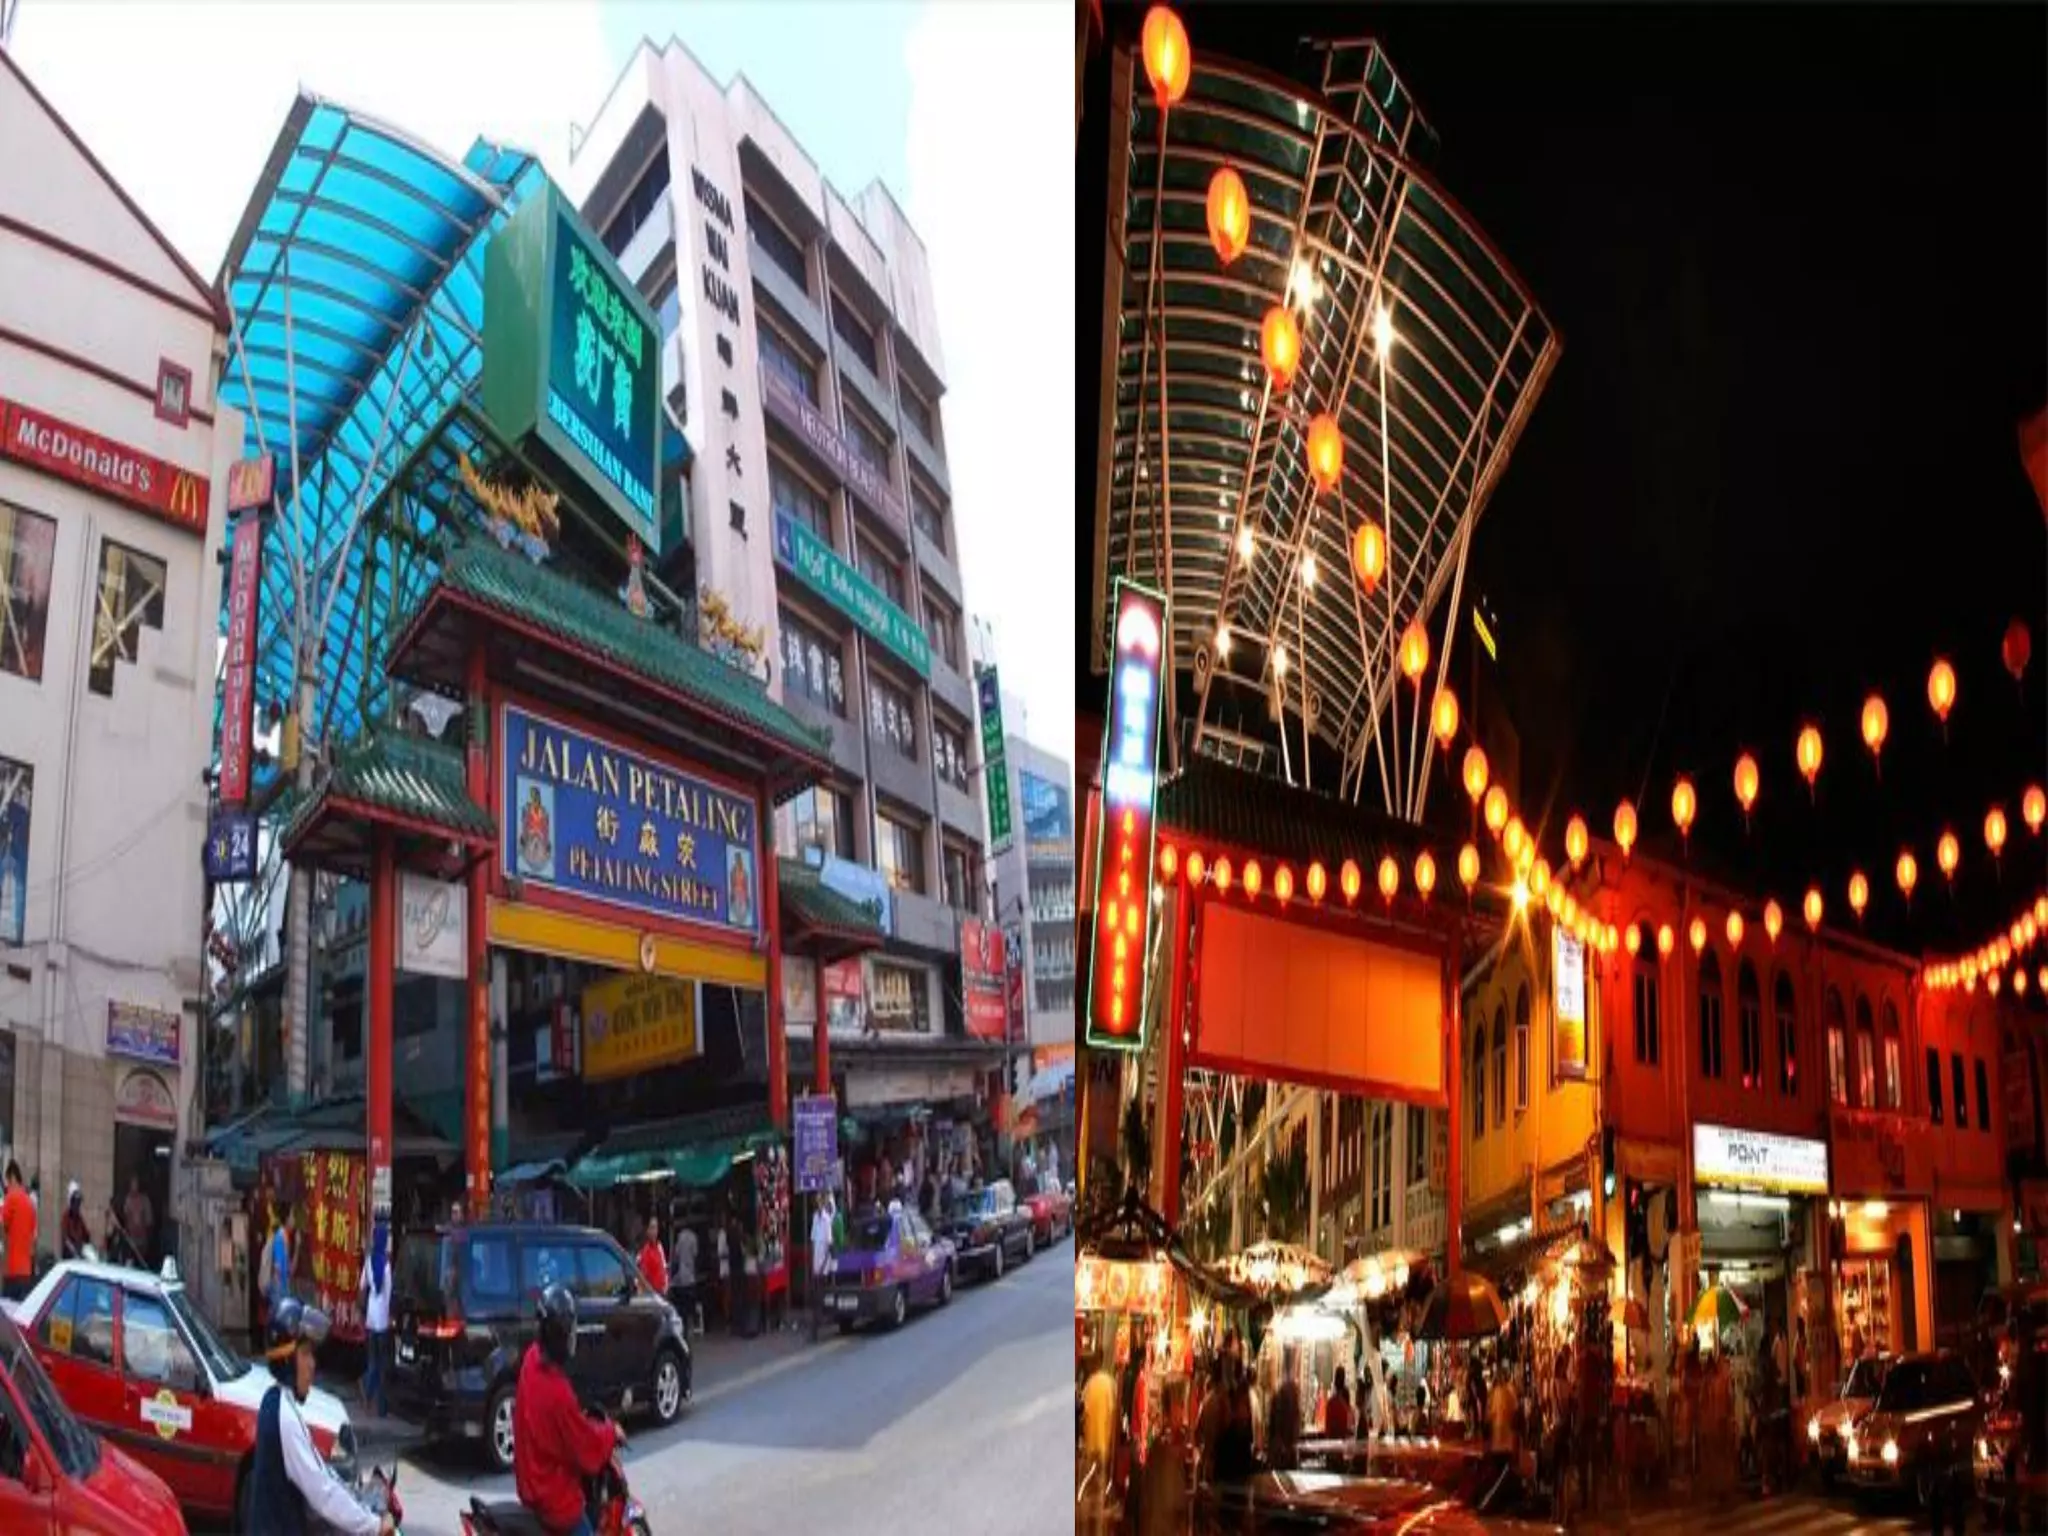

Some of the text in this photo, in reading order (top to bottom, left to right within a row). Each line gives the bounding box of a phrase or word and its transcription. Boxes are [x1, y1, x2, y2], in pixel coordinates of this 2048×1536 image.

[18, 417, 150, 493] McDonald's
[521, 729, 748, 843] JALAN PETALING
[231, 827, 250, 858] 24
[569, 844, 719, 913] PETALING STREET
